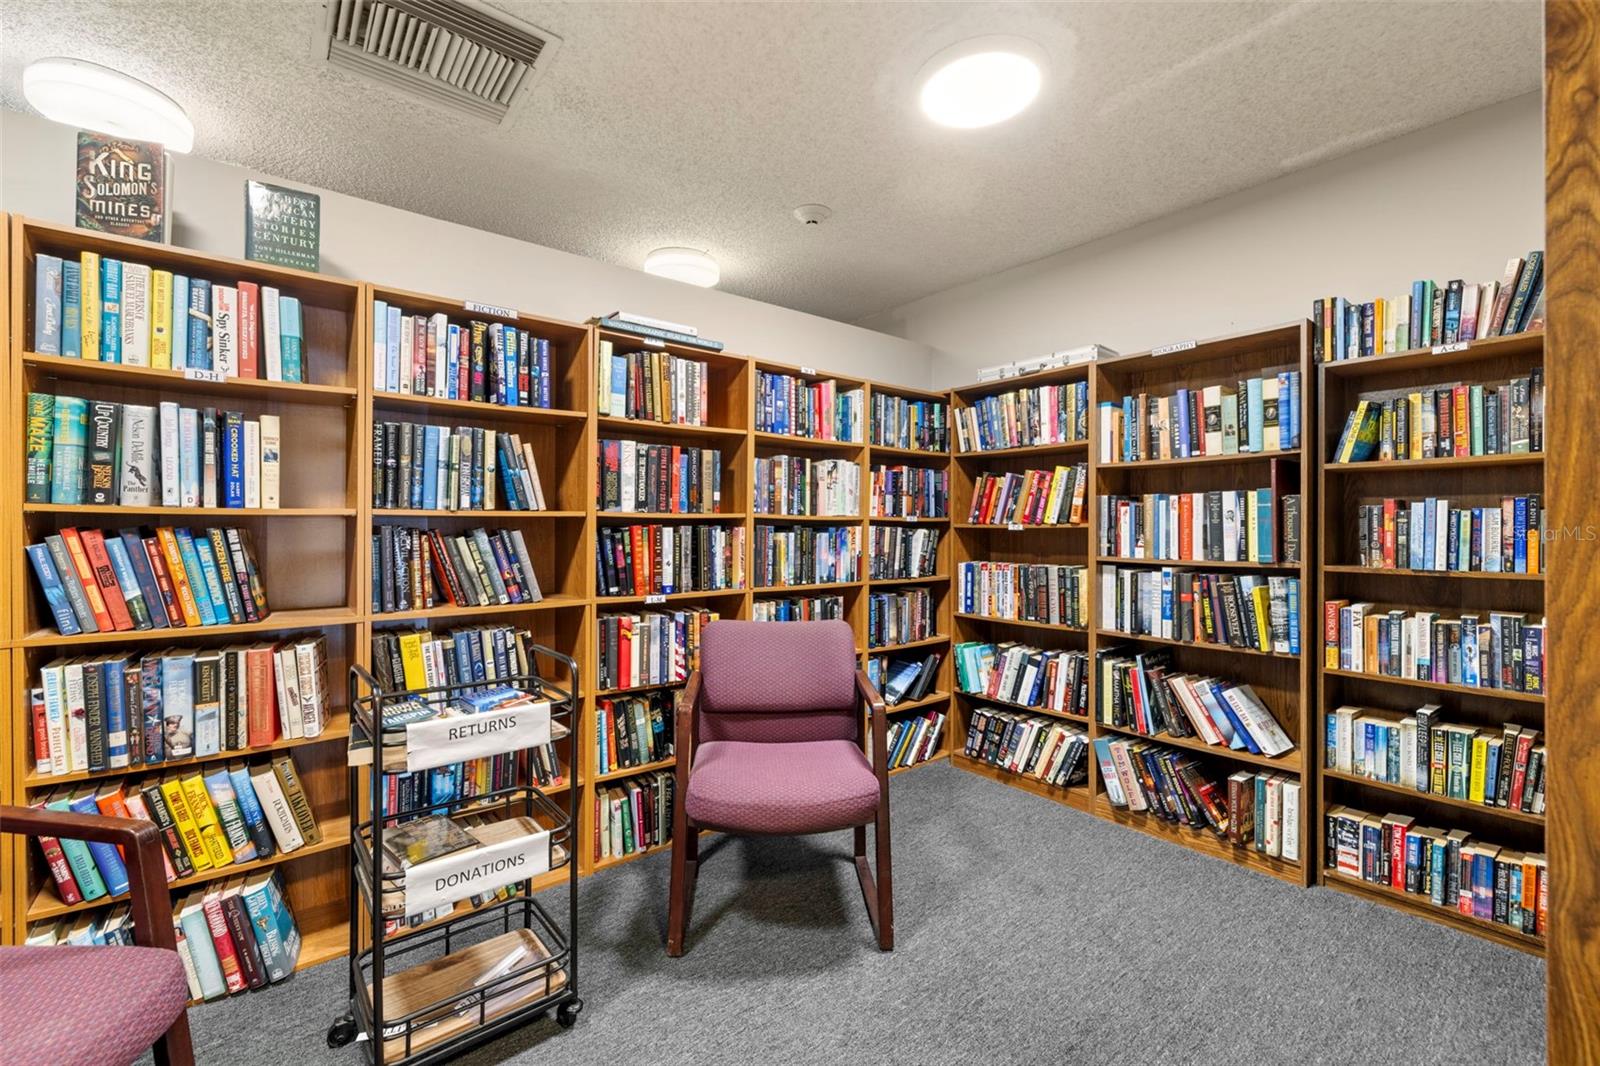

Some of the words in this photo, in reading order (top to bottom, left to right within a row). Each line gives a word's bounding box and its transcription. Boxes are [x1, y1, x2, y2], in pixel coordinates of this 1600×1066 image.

[83, 175, 158, 199] SOLOMON'S
[90, 199, 151, 218] MINES
[254, 221, 316, 239] STORIES
[254, 231, 316, 249] CENTURY
[216, 312, 230, 331] Spy
[473, 304, 511, 317] FICTION
[219, 332, 230, 364] Sinker
[507, 331, 515, 356] Griffin
[520, 333, 528, 355] Griffin
[30, 416, 46, 451] MAZE
[132, 419, 144, 439] Nelson
[131, 441, 144, 464] DeMille
[231, 428, 239, 462] CROOKED
[374, 424, 382, 464] FRAMED
[37, 458, 45, 485] NELSON
[1287, 507, 1298, 542] Thousand
[1517, 502, 1526, 537] MIDWIVES
[212, 530, 226, 563] FROZEN
[220, 564, 232, 582] FIRE
[400, 538, 409, 559] CIVIL
[401, 562, 409, 592] ACTION
[1227, 595, 1240, 636] ROOSEVELT
[1247, 601, 1254, 611] MY
[56, 608, 73, 631] flint
[1249, 612, 1259, 640] JOURNEY
[1328, 619, 1336, 641] BROWN
[1353, 611, 1361, 629] FAY
[202, 665, 210, 678] KEN
[85, 672, 98, 698] JOSEPH
[202, 679, 210, 701] FOLLETT
[49, 698, 59, 720] FARMER
[88, 700, 99, 726] FINDER
[1229, 702, 1242, 713] EASY
[1239, 713, 1249, 722] DAY
[449, 716, 517, 740] RETURNS
[91, 729, 102, 765] VANISHED
[1503, 758, 1512, 776] FOUR
[188, 790, 204, 819] FRANCIS
[197, 792, 208, 809] DICK
[289, 790, 314, 832] TAKEOVER
[184, 829, 196, 841] DICK
[225, 820, 247, 849] FRANZEN
[188, 841, 204, 858] FRANCIS
[1393, 839, 1401, 861] CLANCY
[435, 853, 526, 892] DONATIONS
